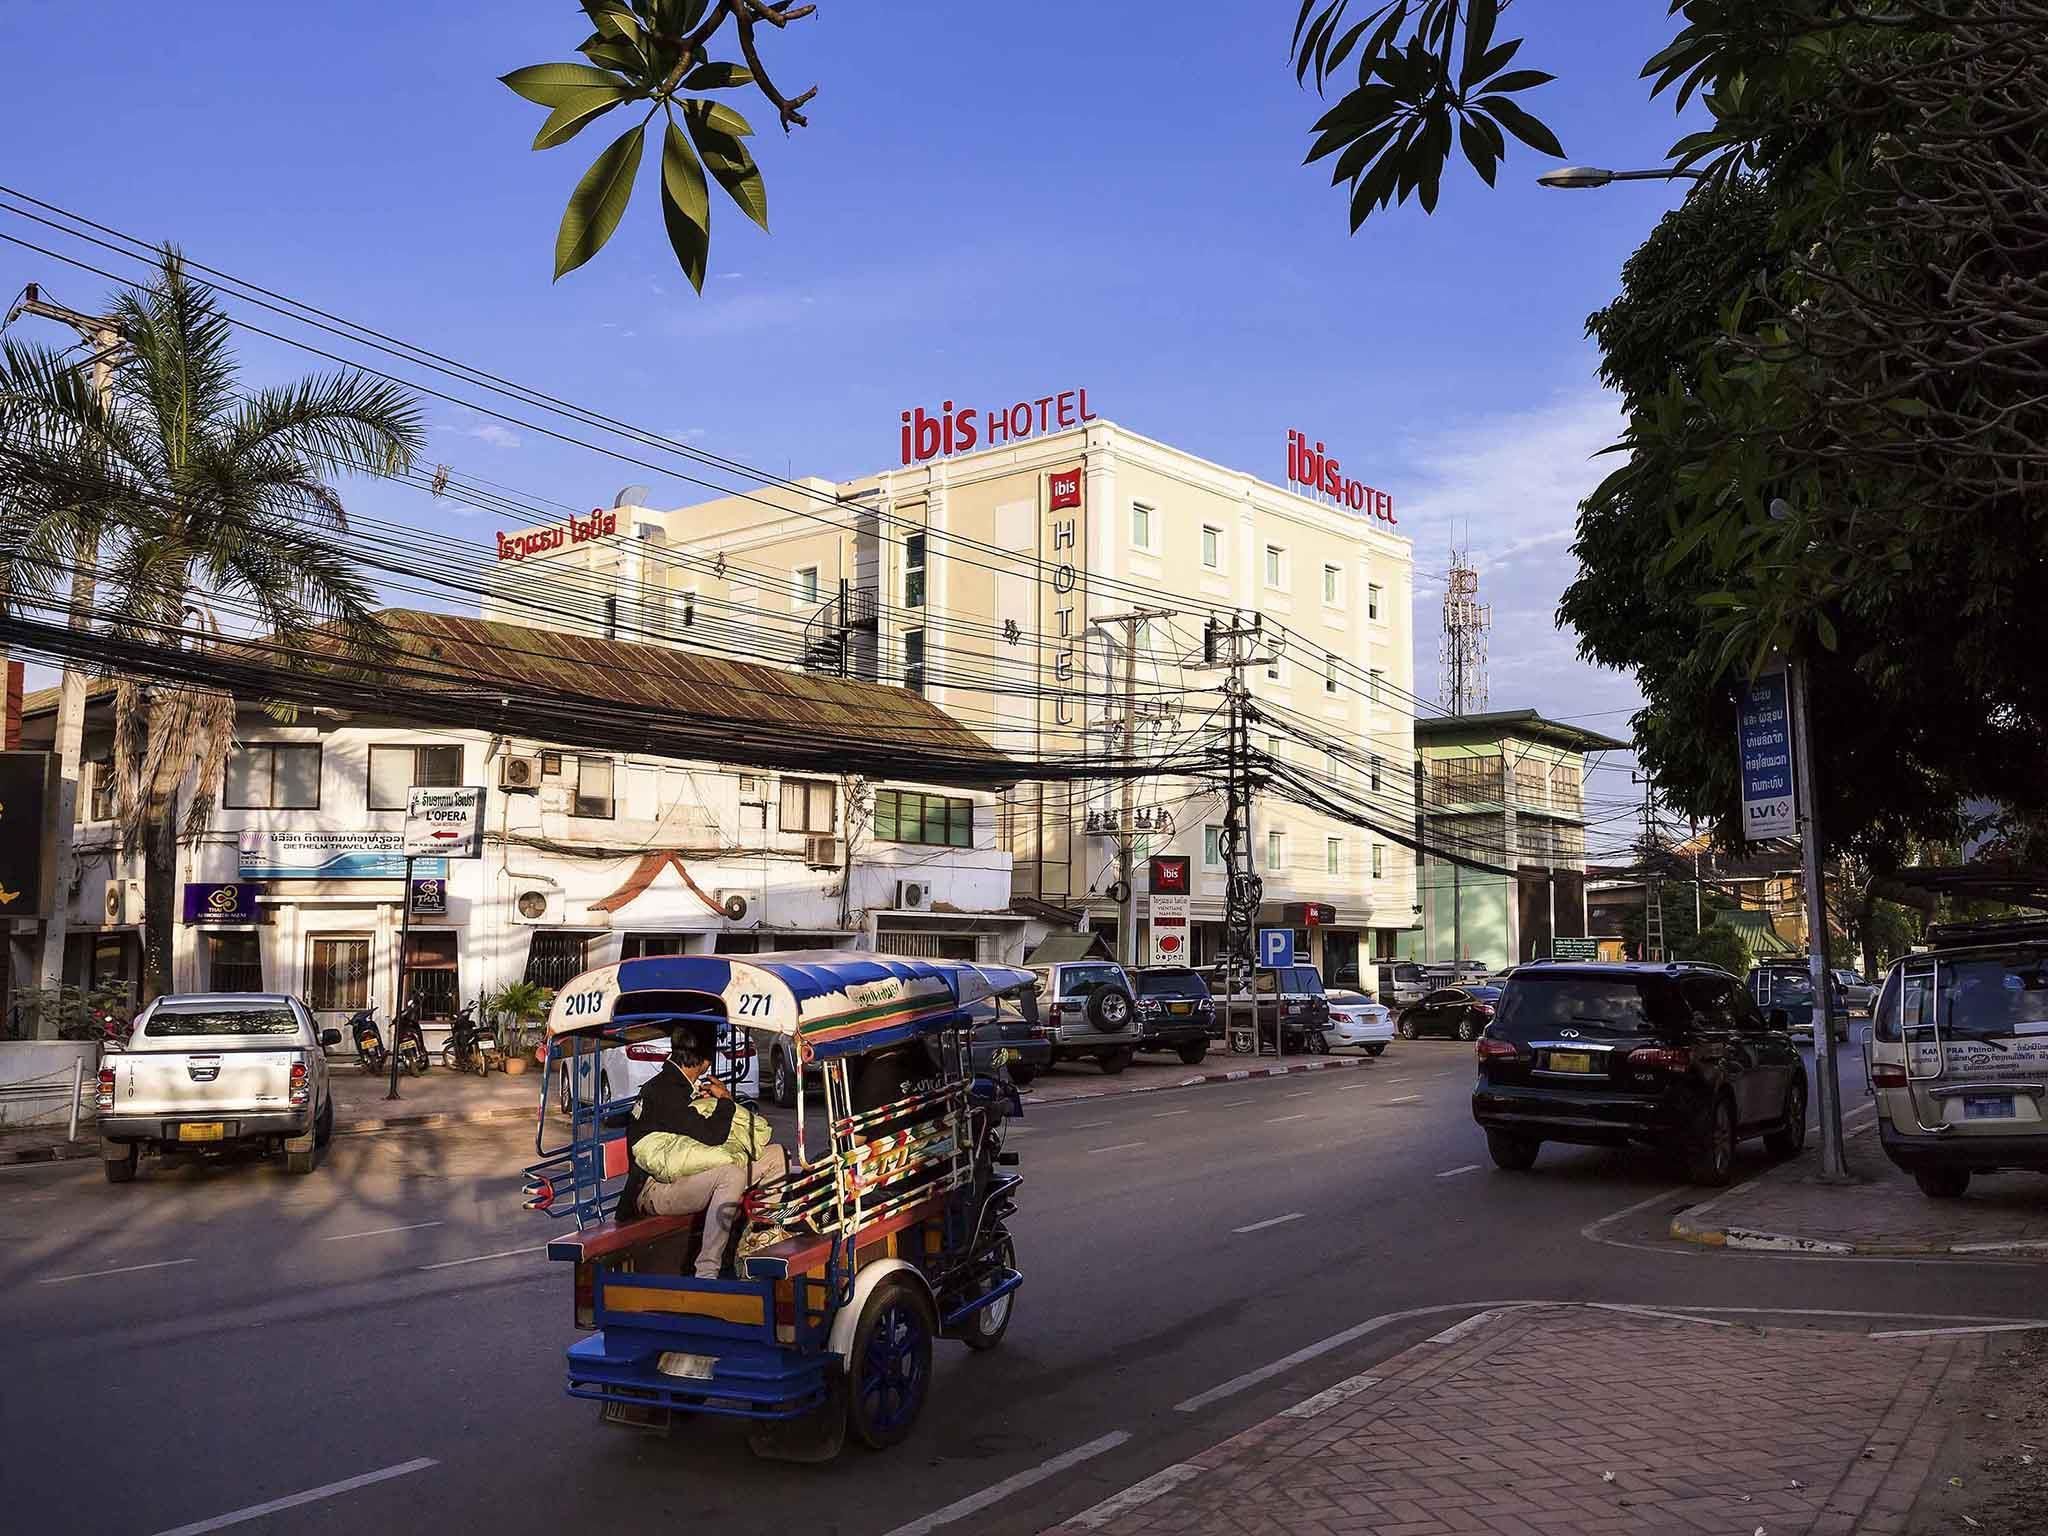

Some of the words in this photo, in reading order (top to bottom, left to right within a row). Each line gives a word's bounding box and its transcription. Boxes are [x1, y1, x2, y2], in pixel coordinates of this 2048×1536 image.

[902, 401, 977, 465] ibis
[988, 388, 1097, 444] HOTEL
[1054, 480, 1076, 497] ibis
[1288, 429, 1339, 497] ibis
[1336, 476, 1398, 525] HOTEL
[1054, 519, 1076, 724] HOTEL
[426, 810, 467, 821] L'OPERA
[1750, 804, 1776, 818] LVI
[1163, 867, 1178, 878] ibis
[1268, 932, 1286, 965] P
[565, 991, 602, 1016] 2013
[738, 993, 772, 1017] 271
